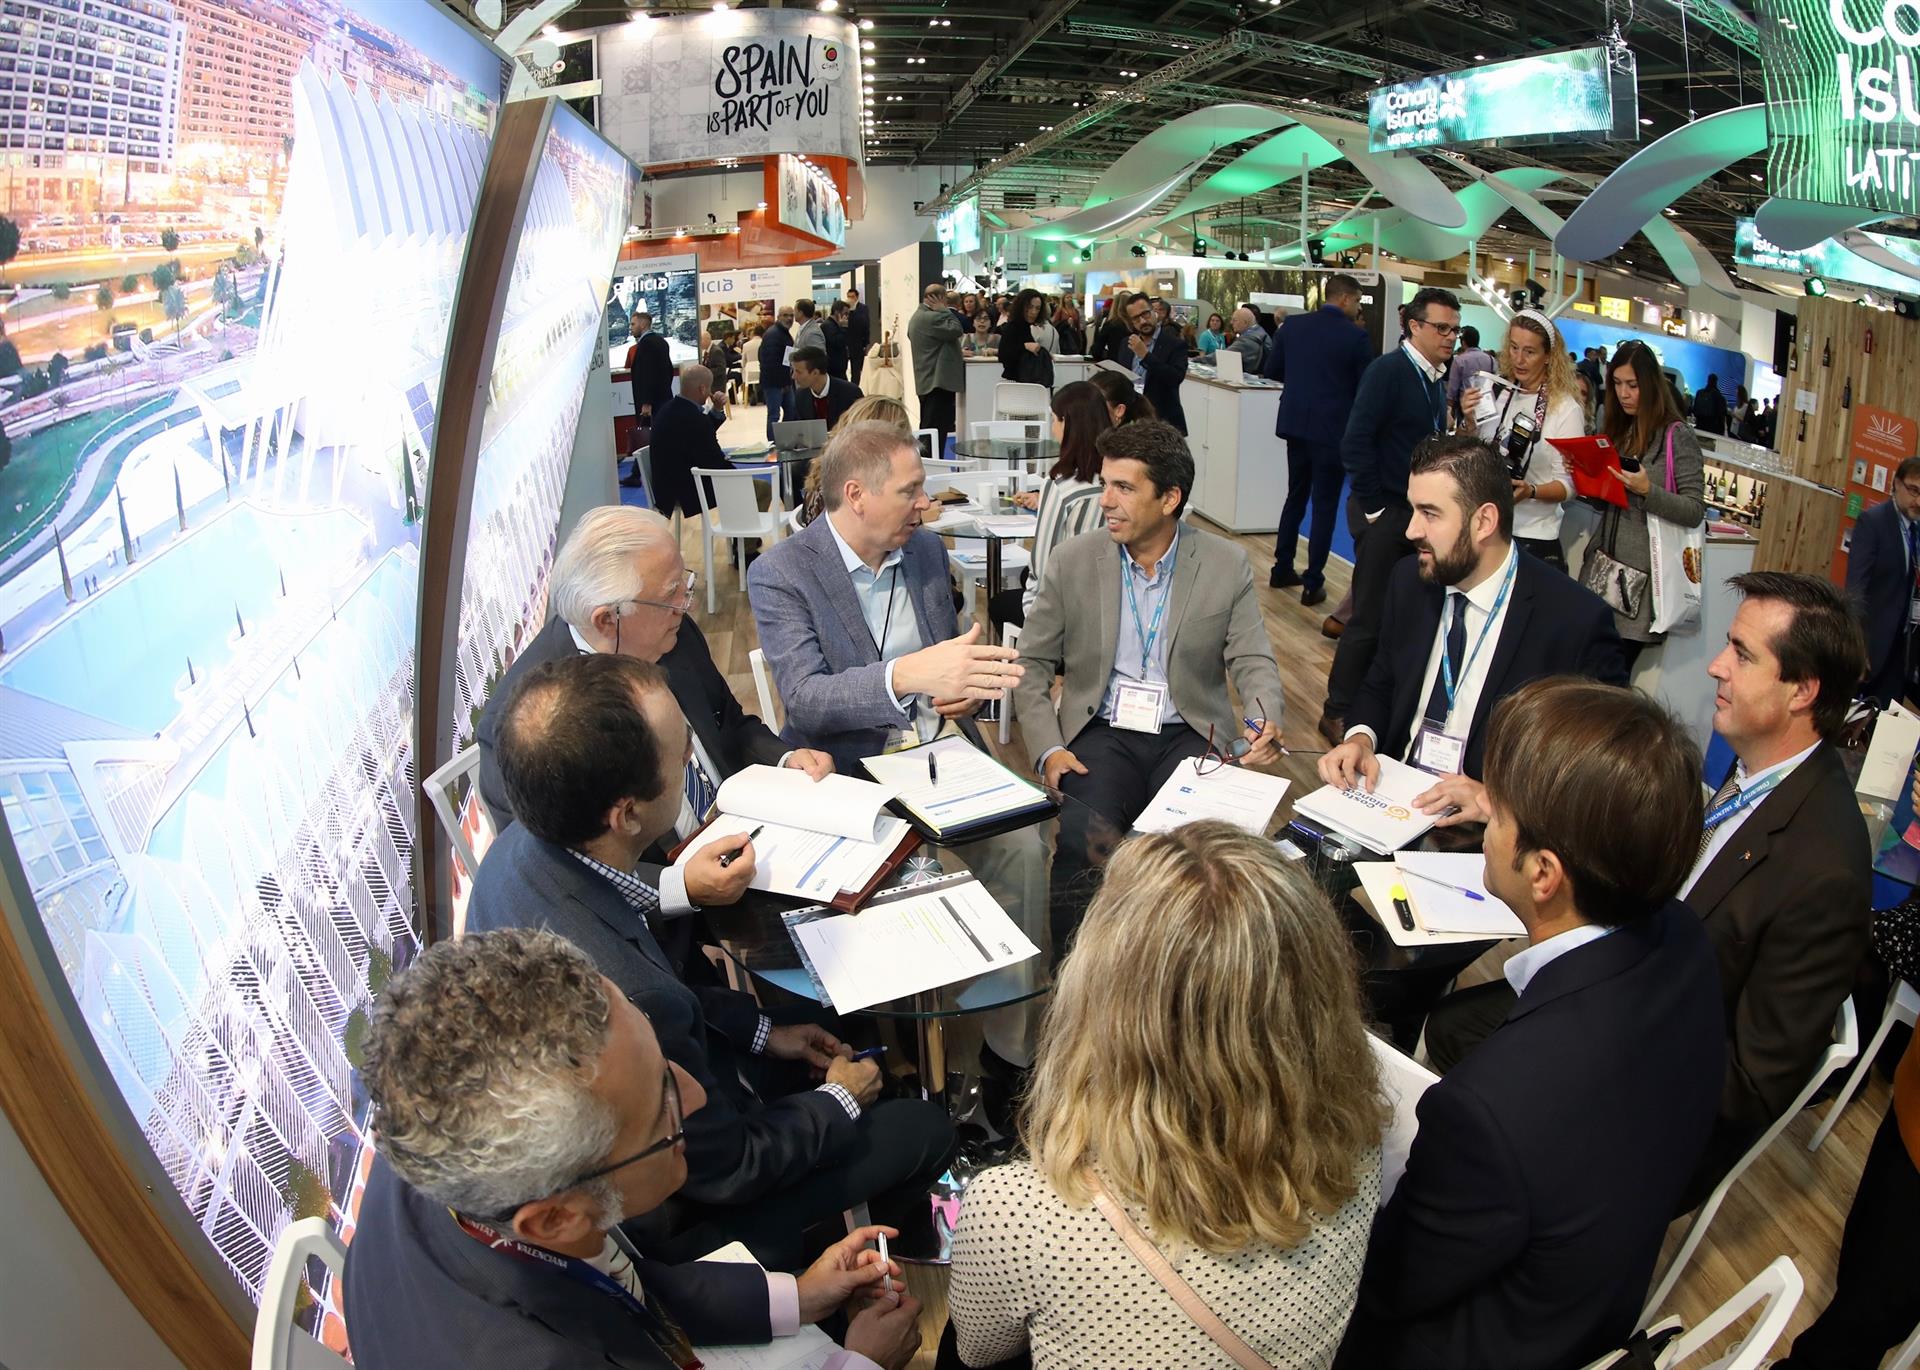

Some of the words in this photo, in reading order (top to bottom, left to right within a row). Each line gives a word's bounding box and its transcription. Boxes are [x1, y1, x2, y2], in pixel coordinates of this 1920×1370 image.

[716, 34, 815, 98] SPAIN,
[707, 112, 720, 133] IS
[720, 90, 781, 135] PART
[776, 96, 794, 117] OF
[795, 84, 828, 120] YOU
[1386, 88, 1438, 111] Canary
[1386, 104, 1438, 130] Islands
[1341, 790, 1376, 809] Costa
[1704, 804, 1733, 826] VALENCIANA
